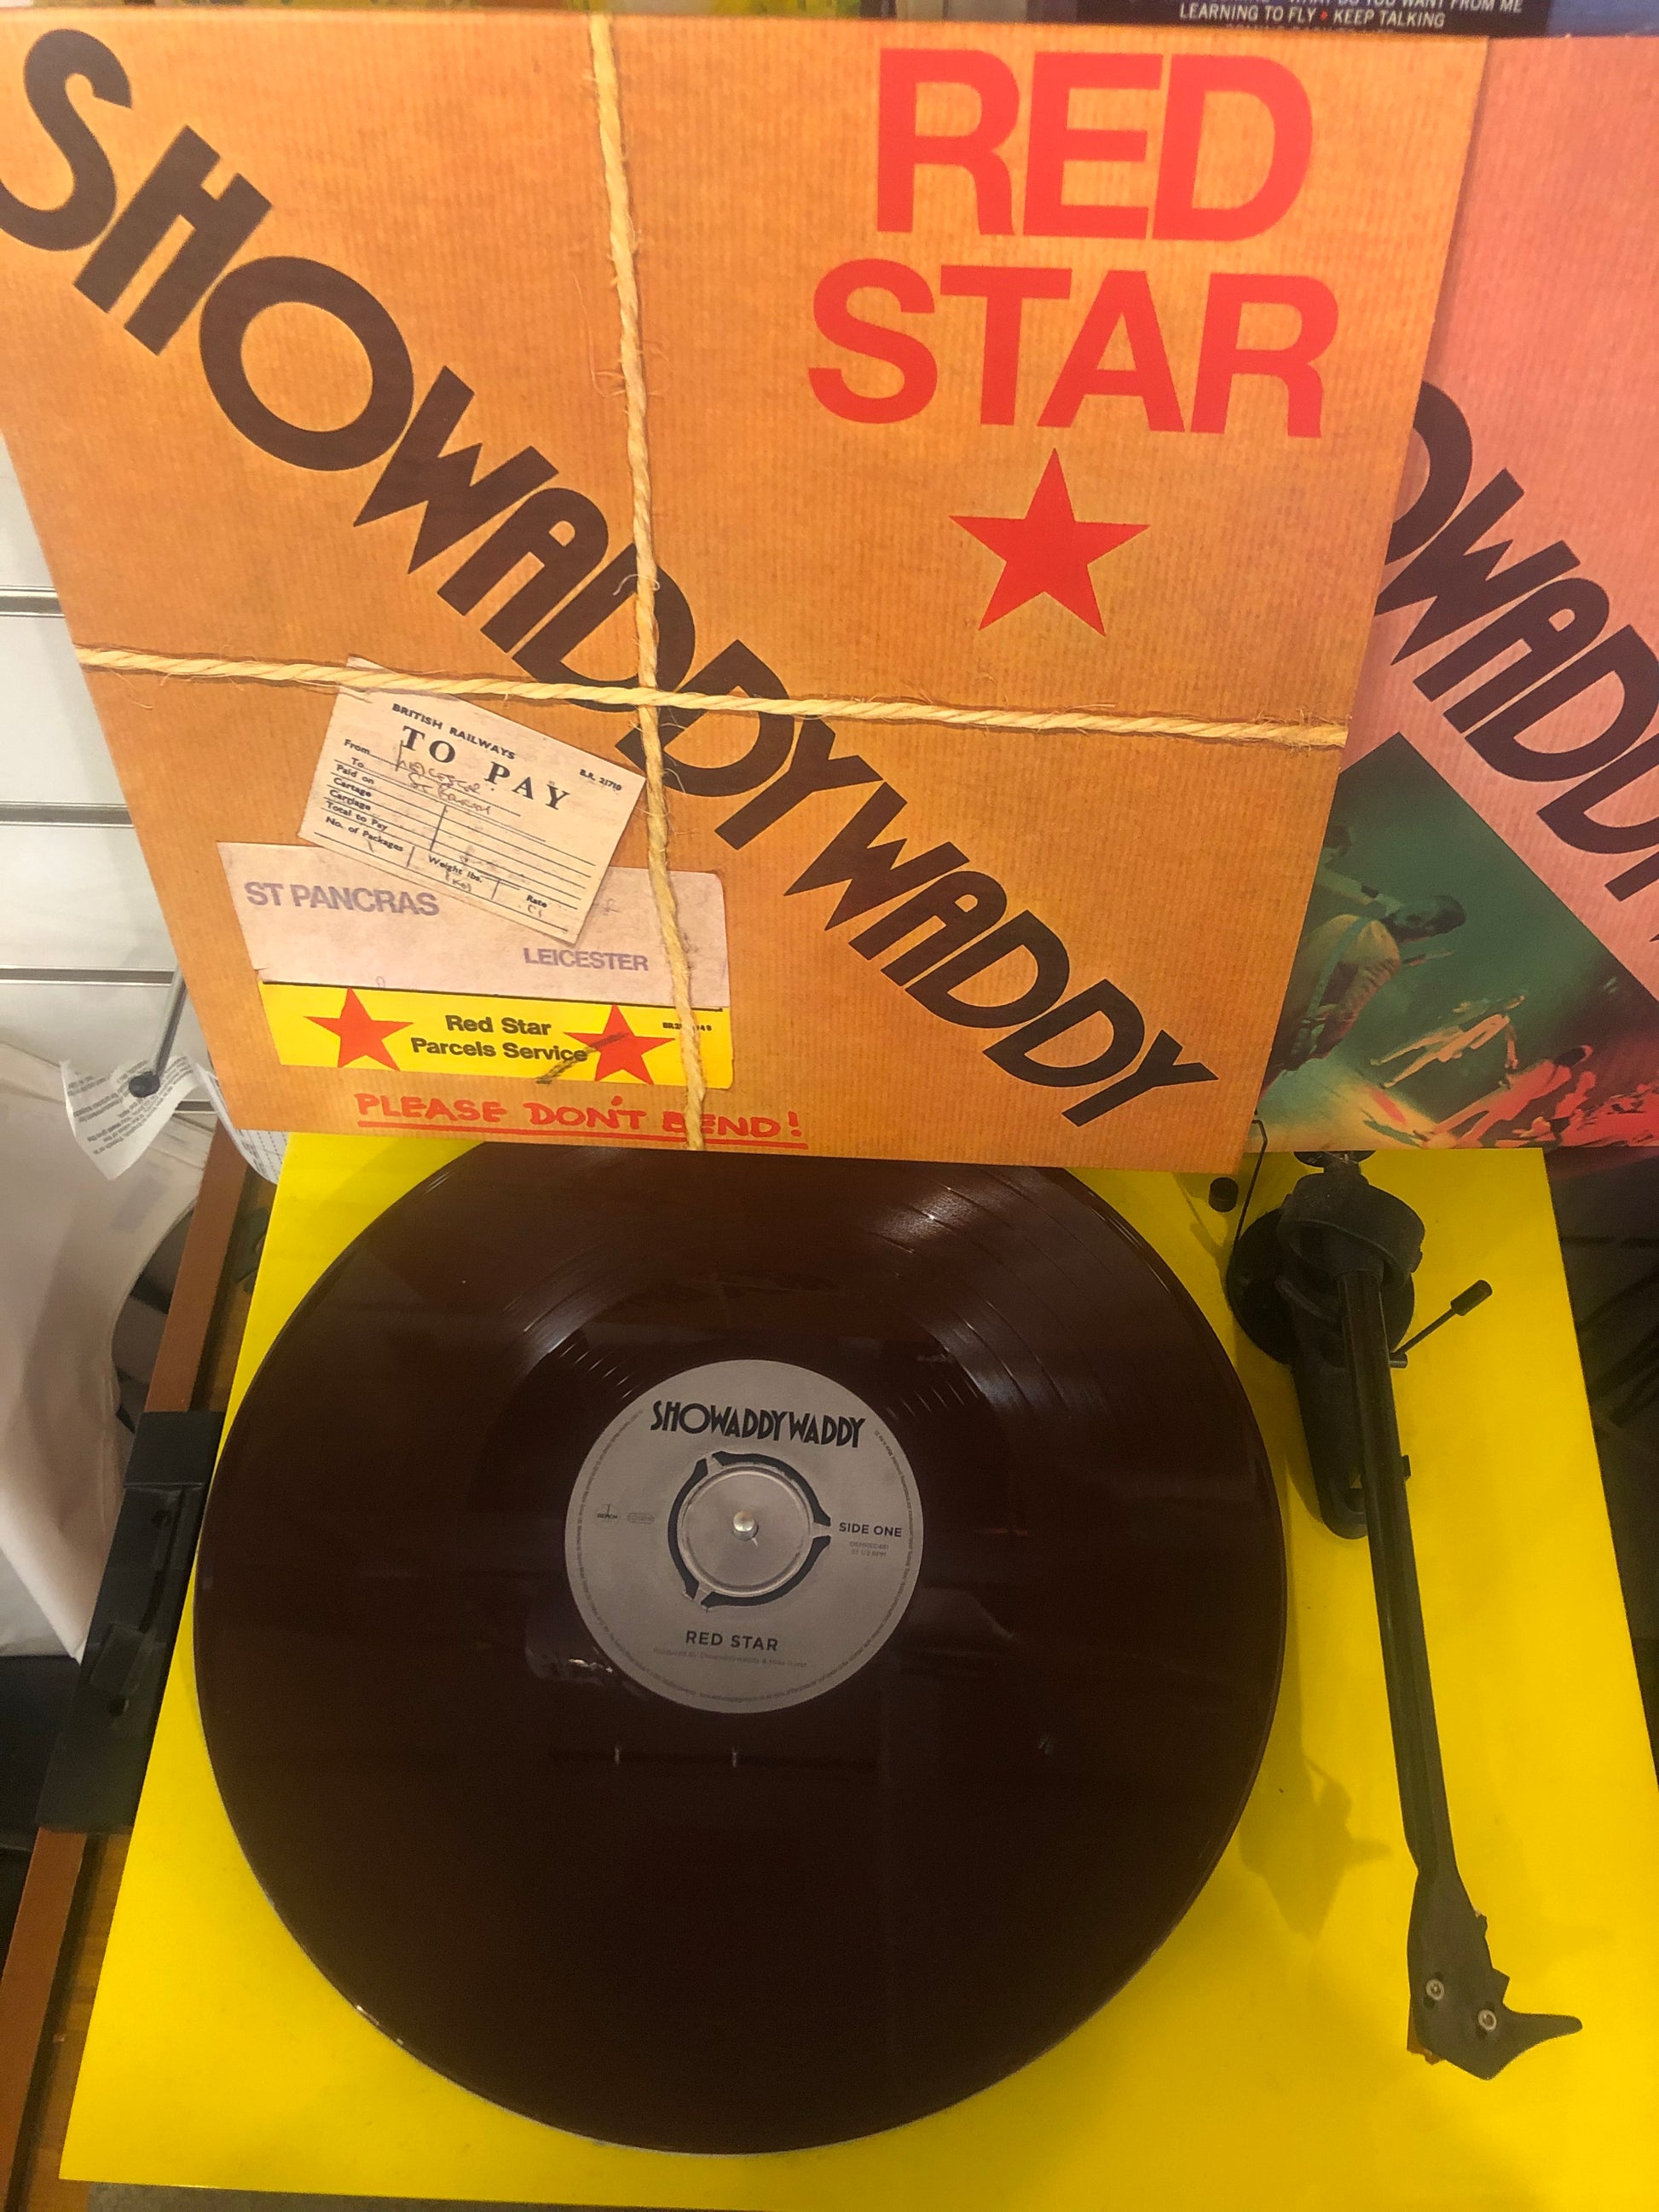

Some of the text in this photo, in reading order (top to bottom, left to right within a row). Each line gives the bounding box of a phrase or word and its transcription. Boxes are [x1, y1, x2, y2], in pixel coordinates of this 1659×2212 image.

[1180, 3, 1258, 20] LEARNING
[1265, 5, 1284, 21] TO
[1287, 6, 1317, 23] FLY
[1333, 9, 1374, 25] KEEP
[1379, 10, 1446, 28] TALKING
[876, 47, 1314, 242] RED
[807, 257, 1339, 439] STAR
[0, 28, 1219, 1128] SHOWADDYWADDY
[391, 703, 517, 760] BRITISH RAILWAYS
[344, 738, 371, 756] From
[336, 764, 374, 785] Paid on
[350, 756, 364, 769] To
[401, 725, 571, 811] TO PAY
[333, 777, 373, 798] Cartage
[326, 800, 388, 832] Total to Pay
[326, 816, 344, 829] No.
[362, 829, 404, 852] Packages
[429, 854, 463, 875] Weight
[466, 870, 483, 884] lbs.
[244, 881, 440, 916] ST PANCRAS
[525, 894, 547, 909] Rate
[523, 947, 649, 972] LEICESTER
[444, 1014, 552, 1036] Red Star
[410, 1037, 588, 1062] Parcels Service
[354, 1092, 508, 1123] PLEASE
[523, 1095, 647, 1130] DON'T
[650, 1400, 866, 1448] SHOWADDYWADDY
[839, 1522, 903, 1538] SIDE ONE
[685, 1630, 779, 1652] RED STAR
